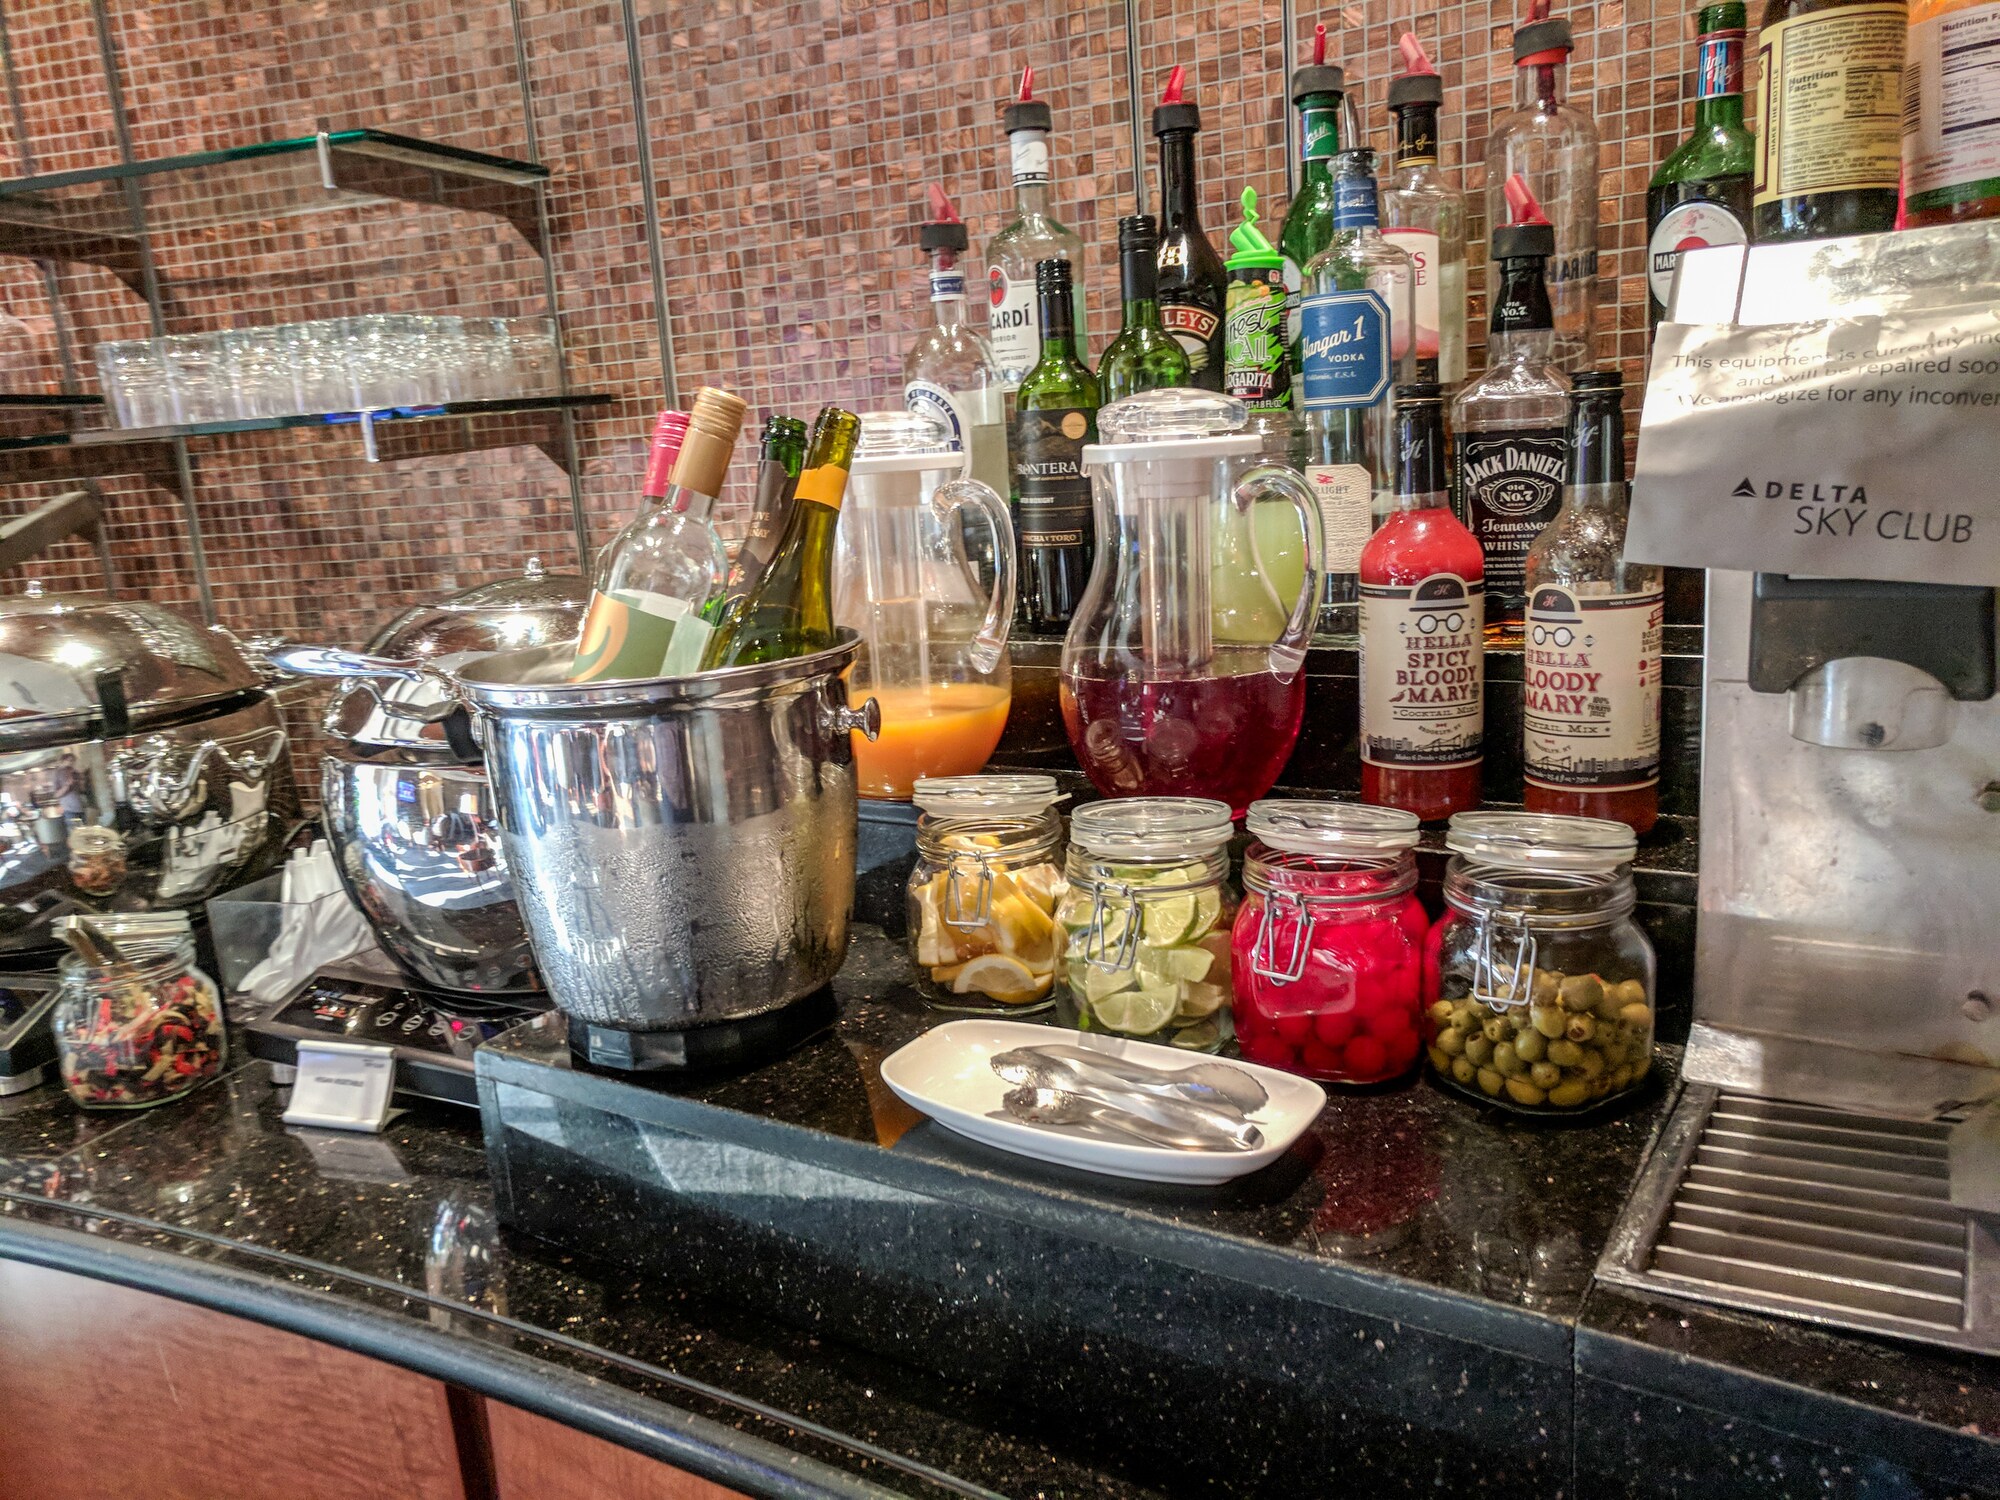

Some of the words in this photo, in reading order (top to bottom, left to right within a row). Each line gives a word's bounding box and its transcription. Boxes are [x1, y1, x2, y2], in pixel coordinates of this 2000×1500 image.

[1942, 16, 1988, 33] Nutrition
[1788, 70, 1838, 87] Nutrition
[1788, 81, 1818, 93] Facts
[1655, 252, 1679, 271] MAR
[1163, 310, 1212, 332] LEYS
[1302, 329, 1352, 362] Hangar
[1353, 315, 1365, 341] 1
[1328, 353, 1365, 363] VODKA
[1671, 355, 1713, 368] This
[1719, 351, 1830, 369] equipment
[1839, 349, 1856, 361] is
[1862, 334, 1965, 358] currently
[1227, 372, 1273, 389] RGARITA
[1736, 374, 1775, 388] and
[1782, 369, 1817, 382] will
[1858, 356, 1950, 377] repaired
[1958, 359, 1999, 374] soo
[1827, 384, 1857, 401] for
[1863, 388, 1902, 408] any
[1016, 461, 1079, 475] RONTERA
[1463, 454, 1505, 486] JACK
[1765, 481, 1868, 505] DELTA
[1794, 505, 1868, 537] SKY
[1876, 509, 1974, 544] CLUB
[1483, 541, 1532, 551] WHISK
[1406, 634, 1473, 650] HELLA
[1408, 650, 1470, 669] SPICY
[1526, 648, 1592, 668] HELLA
[1396, 665, 1477, 686] BLOODY
[1525, 667, 1602, 693] LOODY
[1408, 684, 1470, 703] MARY
[1525, 689, 1588, 715] MARY
